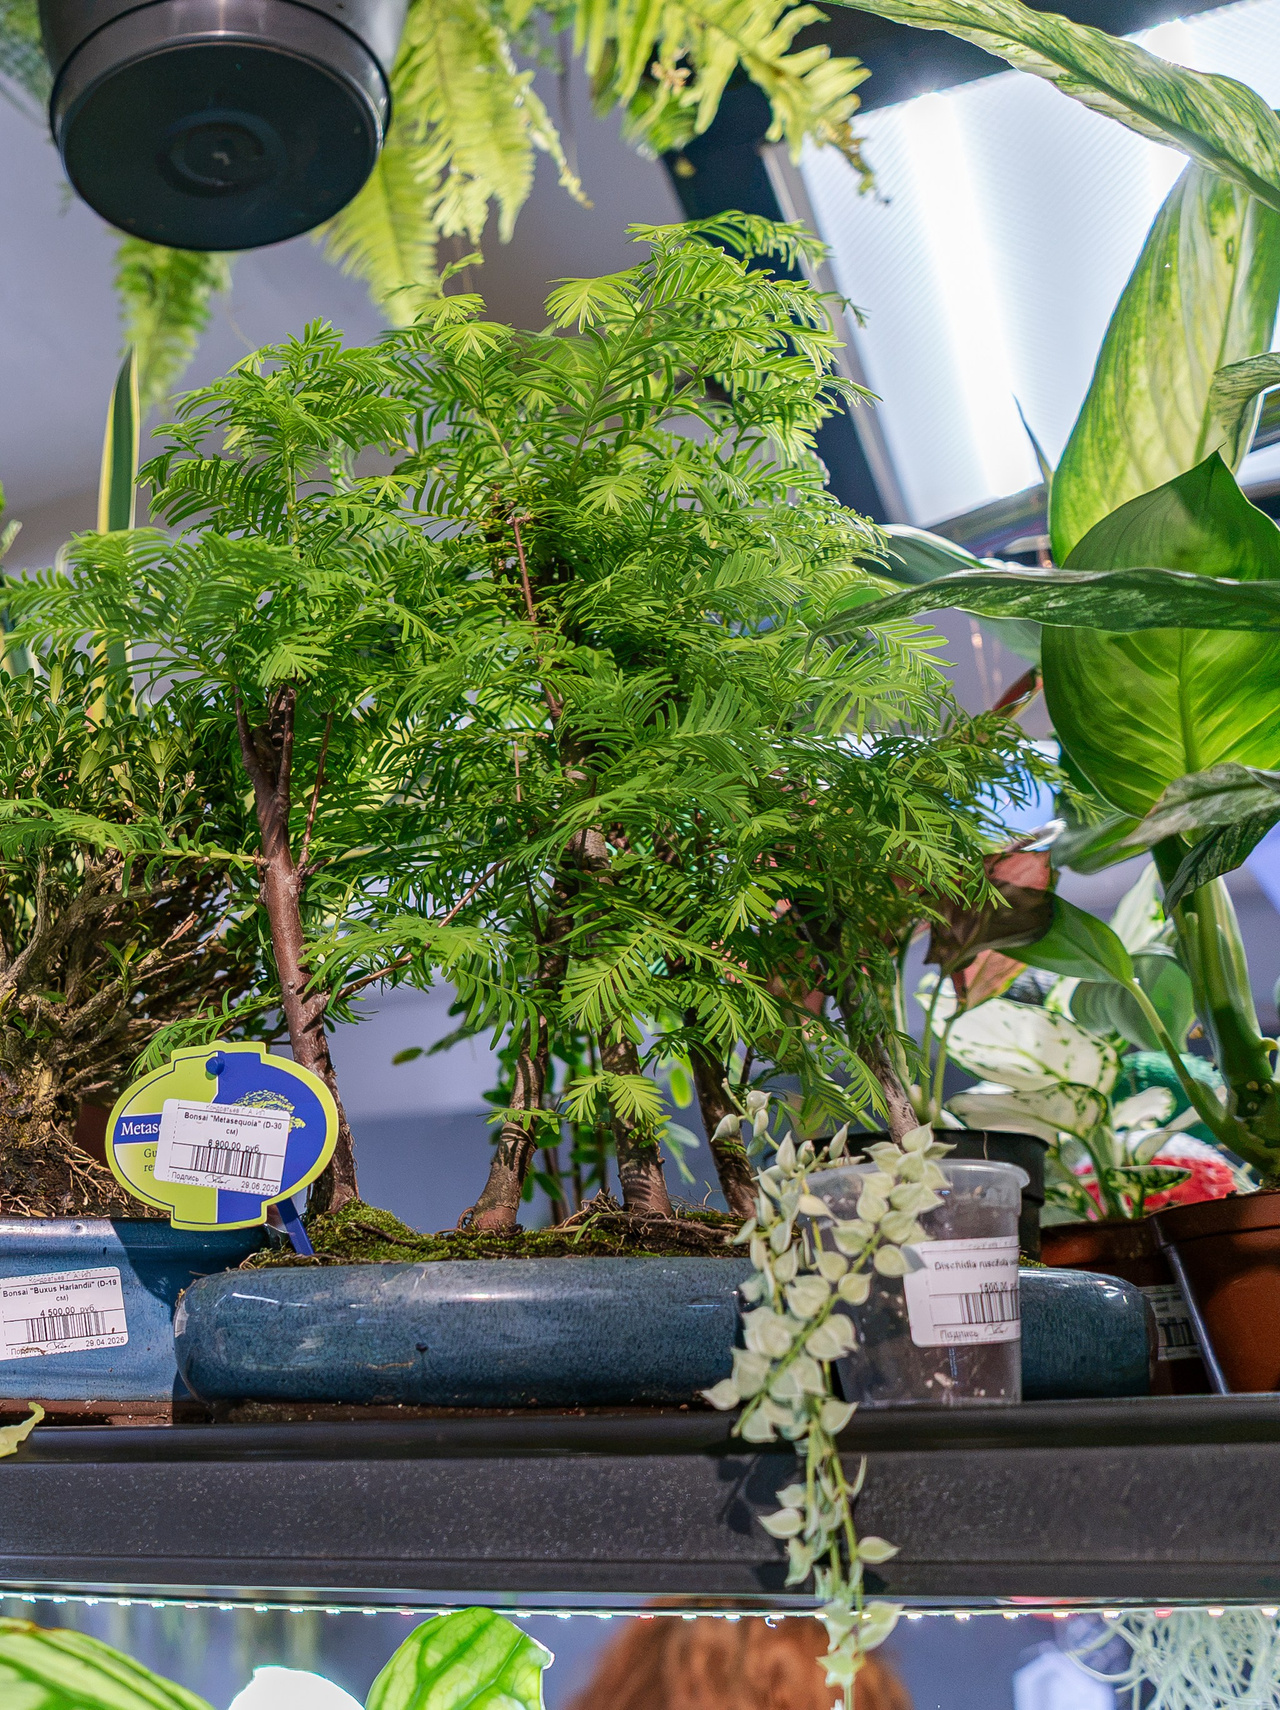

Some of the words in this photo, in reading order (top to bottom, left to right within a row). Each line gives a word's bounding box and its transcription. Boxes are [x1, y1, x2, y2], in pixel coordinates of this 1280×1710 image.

[121, 1121, 161, 1136] Metas
[184, 1112, 209, 1122] Bonsai
[210, 1115, 262, 1127] "Metasequoia"
[263, 1122, 283, 1131] (D-30
[225, 1128, 239, 1137] см)
[171, 1171, 199, 1183] Подпись
[241, 1181, 280, 1194] 29.06.2026
[3, 1288, 29, 1298] Bonsai
[30, 1284, 58, 1295] "Buxus
[59, 1281, 95, 1291] Harlandii"
[97, 1278, 118, 1288] (D-19
[55, 1293, 69, 1302] см)
[86, 1336, 125, 1348] 29.04.2026
